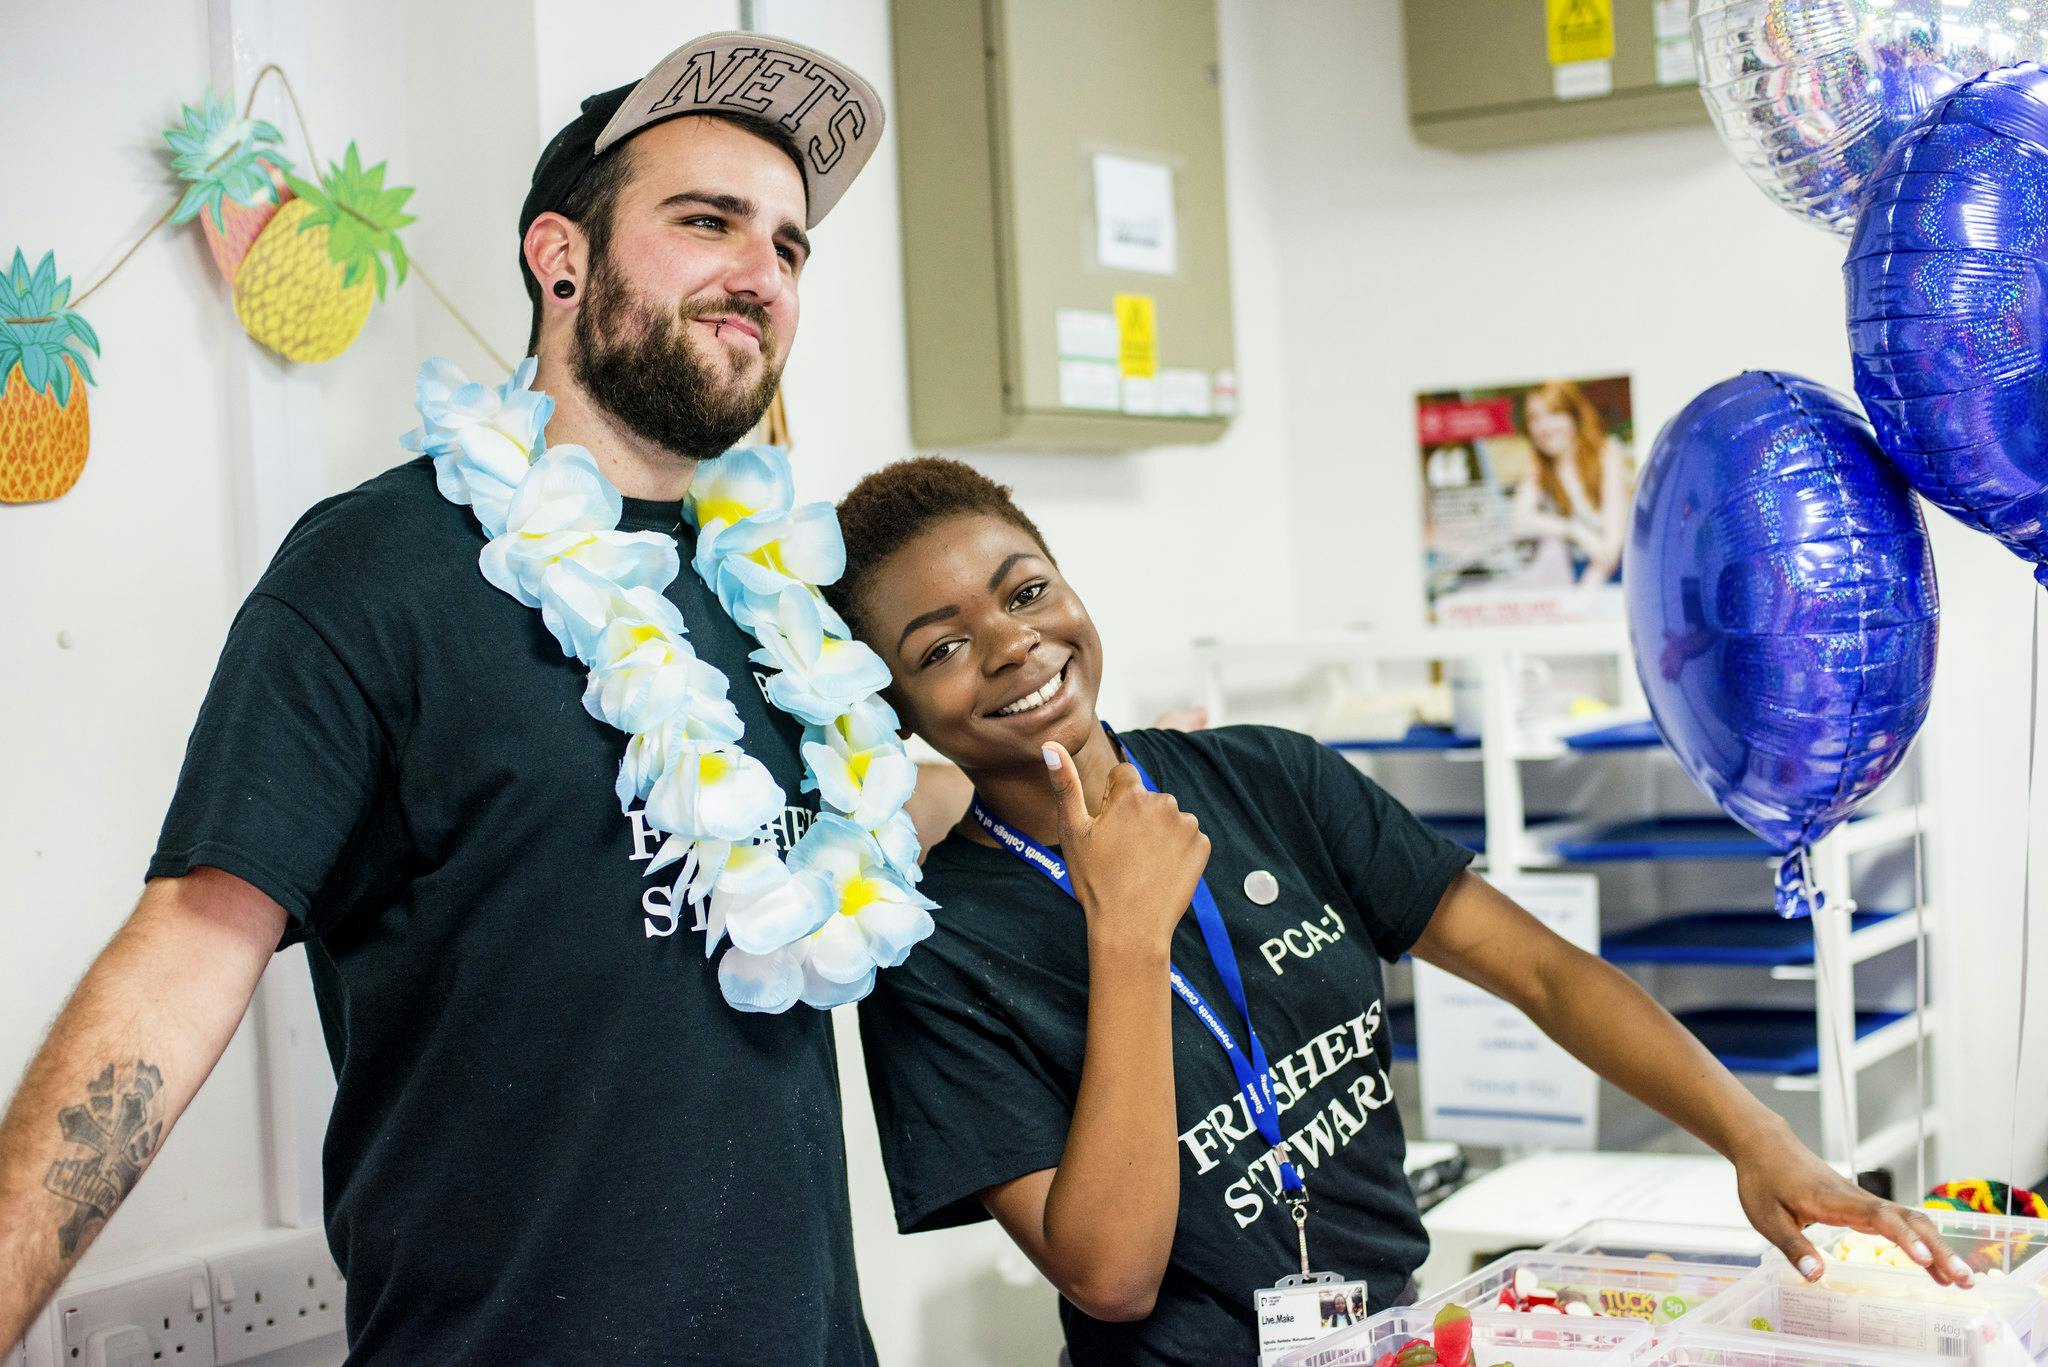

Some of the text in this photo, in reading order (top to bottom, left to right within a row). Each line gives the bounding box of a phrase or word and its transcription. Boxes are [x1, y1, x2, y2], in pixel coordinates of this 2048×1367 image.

[649, 47, 867, 175] NETS
[982, 816, 993, 828] of
[993, 824, 1025, 852] College
[1024, 845, 1066, 880] Plymouth
[1197, 1004, 1235, 1050] Plymouth
[1246, 1082, 1266, 1115] Student
[1600, 1289, 1655, 1313] TUCK
[1933, 1322, 1961, 1338] 840g
